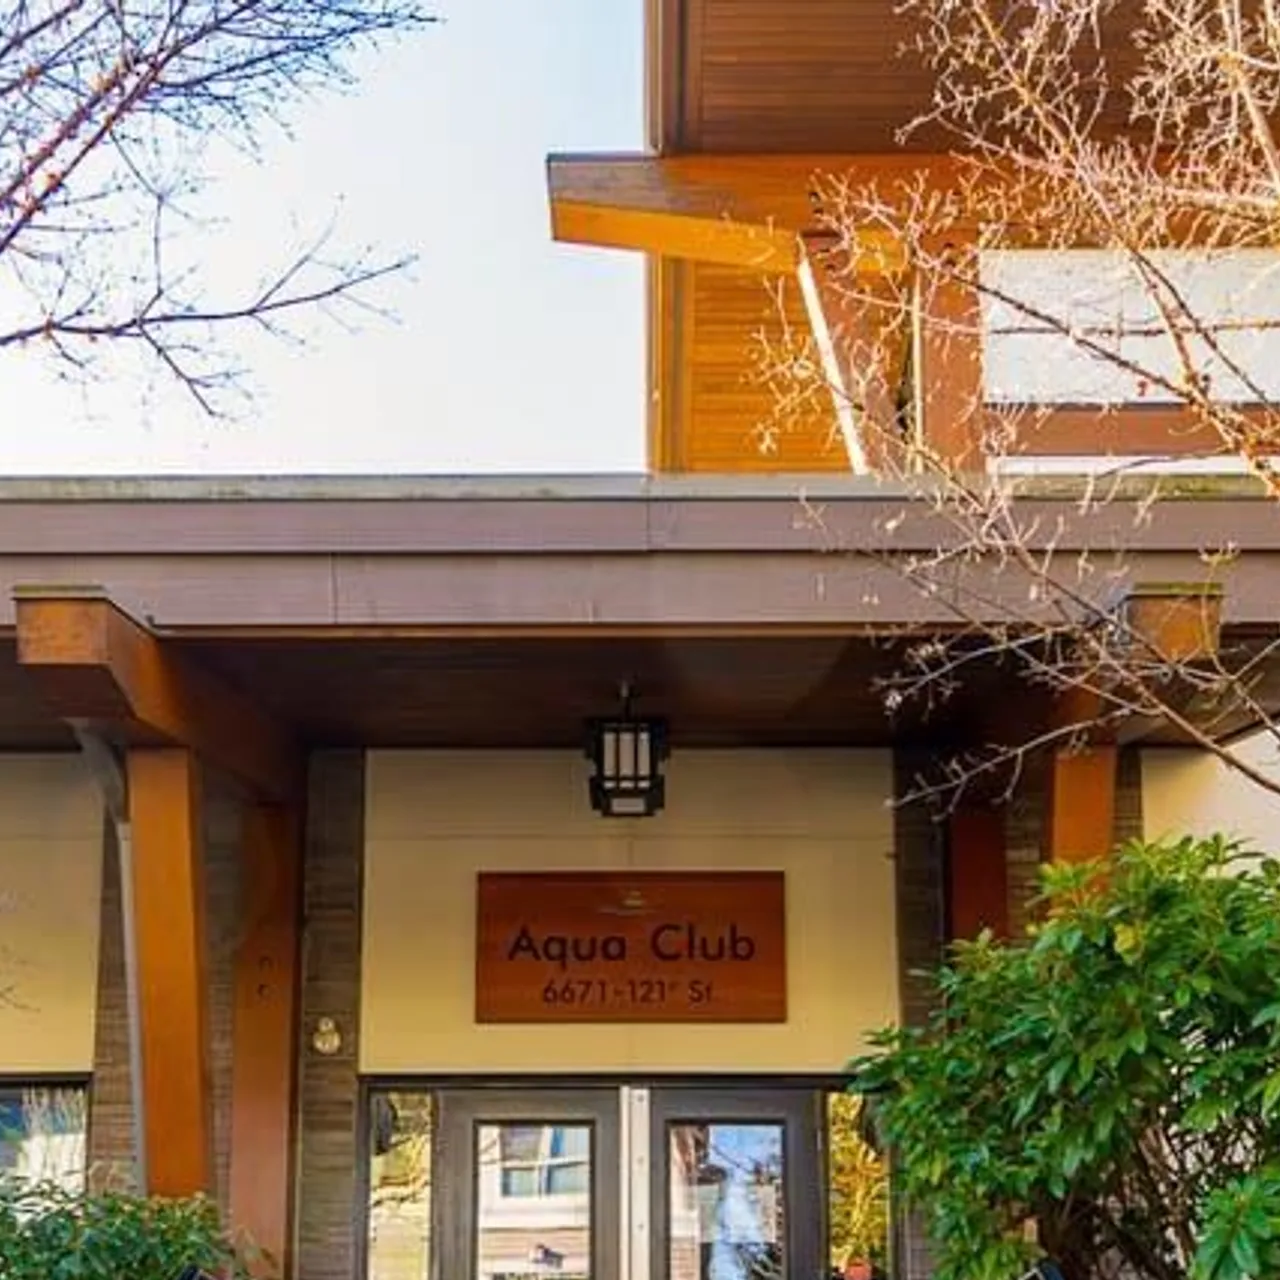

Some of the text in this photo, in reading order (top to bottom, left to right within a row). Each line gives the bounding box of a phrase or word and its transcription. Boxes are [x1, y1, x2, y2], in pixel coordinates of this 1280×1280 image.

[507, 923, 756, 971] Aqua Club
[543, 978, 679, 1004] 6671-121
